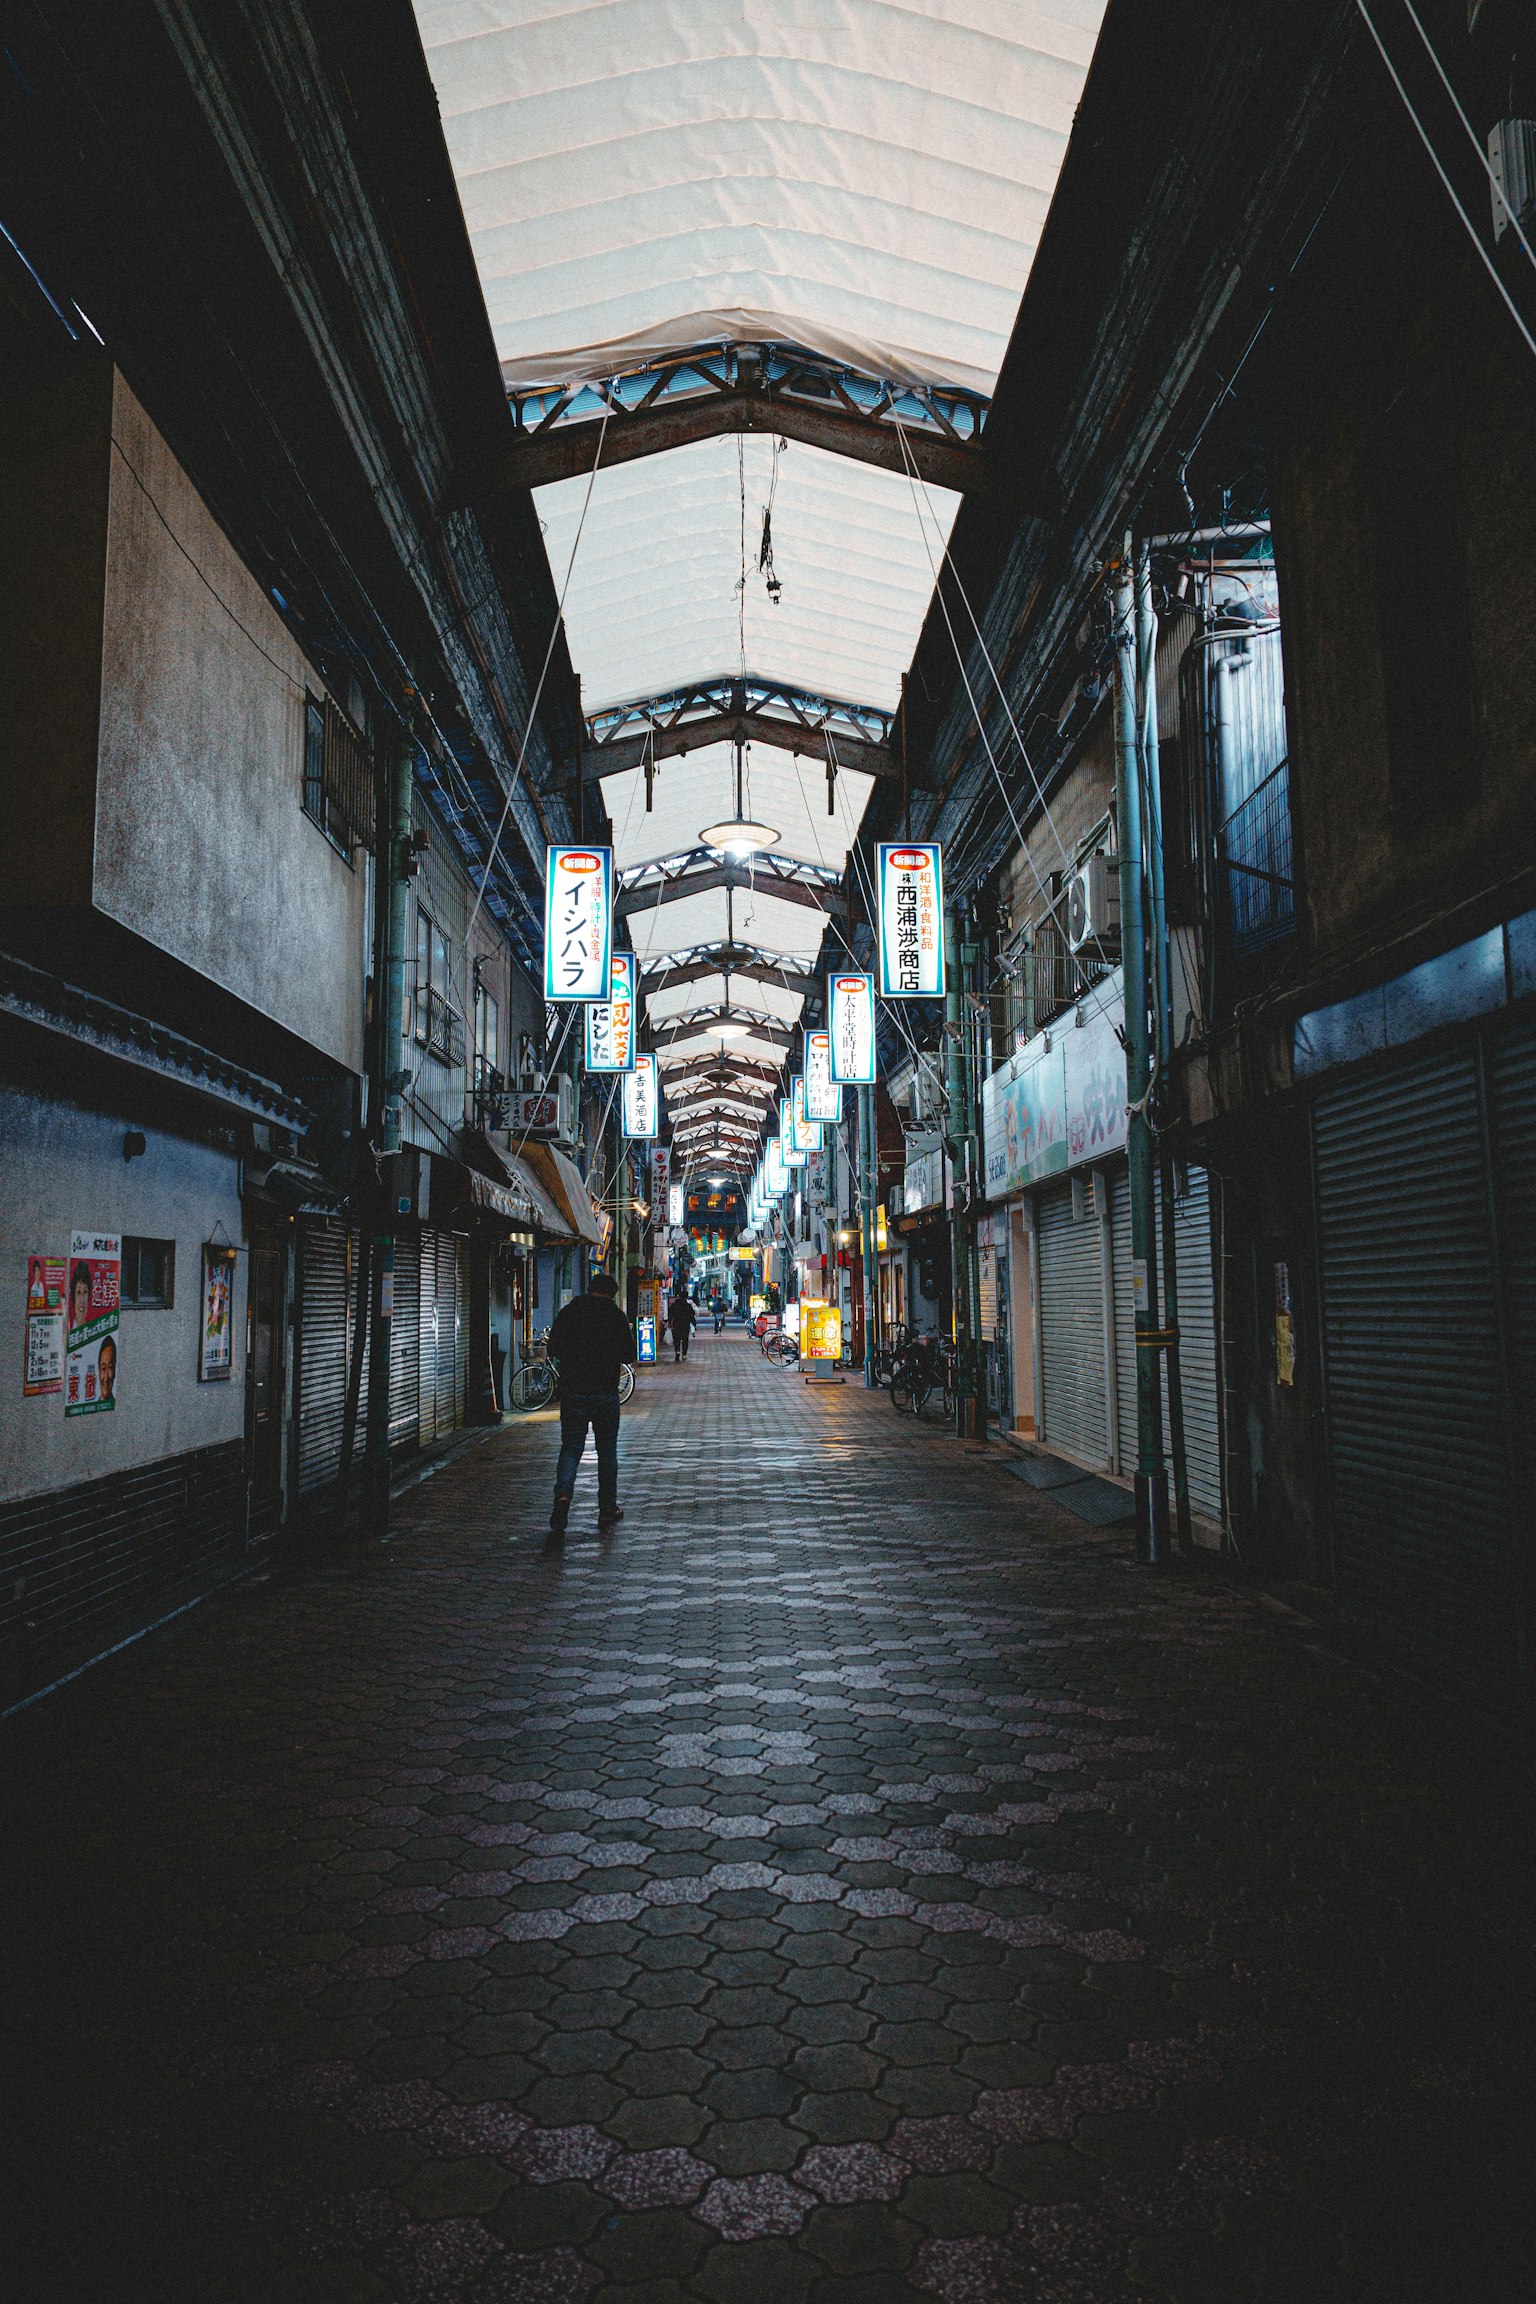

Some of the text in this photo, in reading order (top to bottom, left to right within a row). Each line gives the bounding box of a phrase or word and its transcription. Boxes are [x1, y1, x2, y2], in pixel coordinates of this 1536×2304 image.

[564, 857, 598, 869] 新開筋
[893, 854, 926, 866] 新開筋
[561, 880, 587, 988] イシハラ
[592, 1007, 609, 1060] にしだ
[842, 994, 857, 1079] 太平堂時計店
[634, 1073, 647, 1132] 吉美酒店
[657, 1166, 668, 1223] アサヒビール
[810, 1327, 837, 1340] 運命
[68, 1375, 80, 1403] 東
